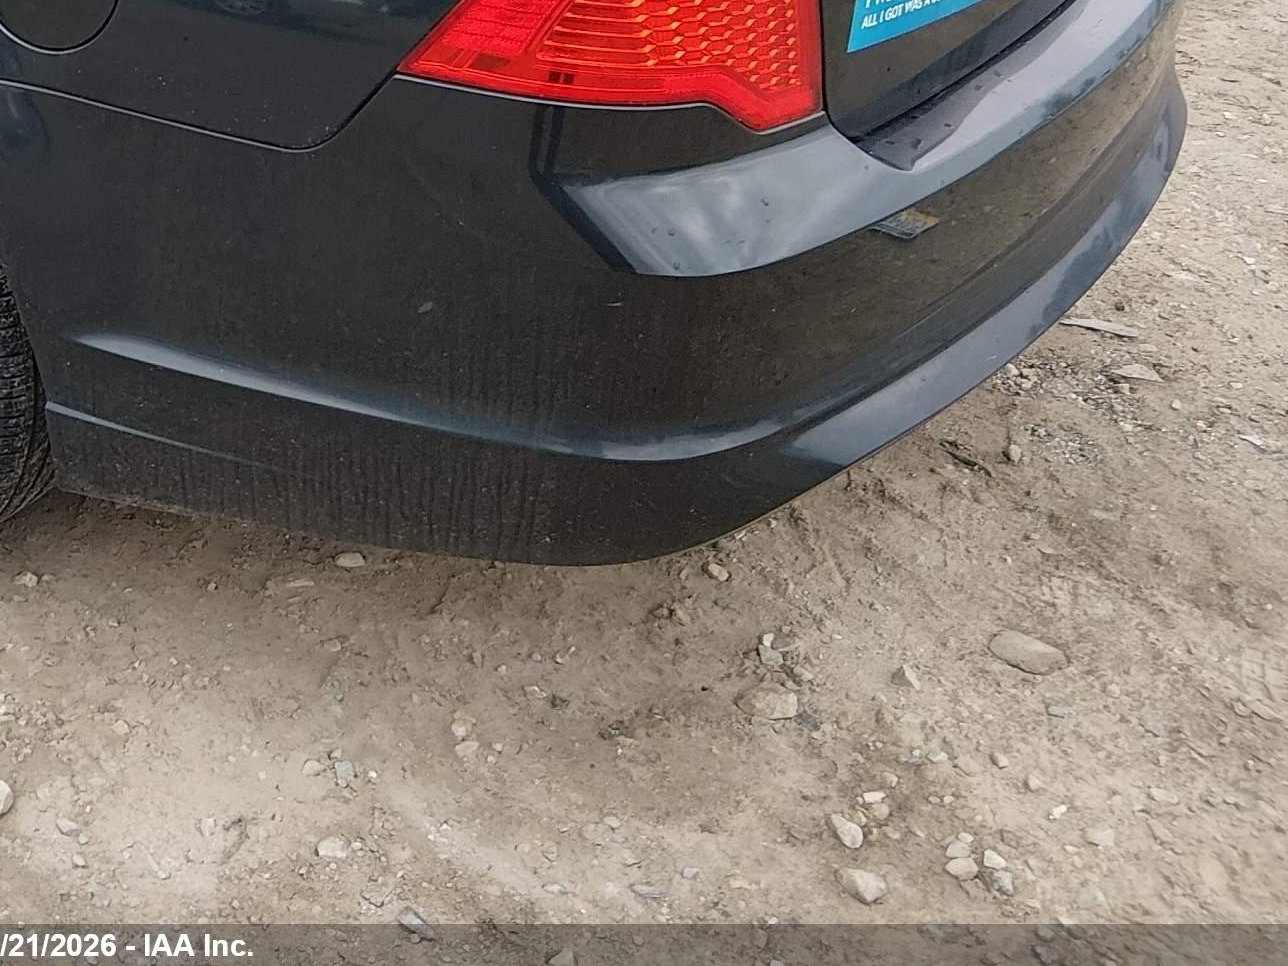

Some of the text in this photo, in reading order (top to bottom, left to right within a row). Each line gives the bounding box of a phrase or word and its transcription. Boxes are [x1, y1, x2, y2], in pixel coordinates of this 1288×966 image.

[860, 12, 878, 30] ALL
[879, 10, 885, 23] I
[884, 3, 904, 21] GOT
